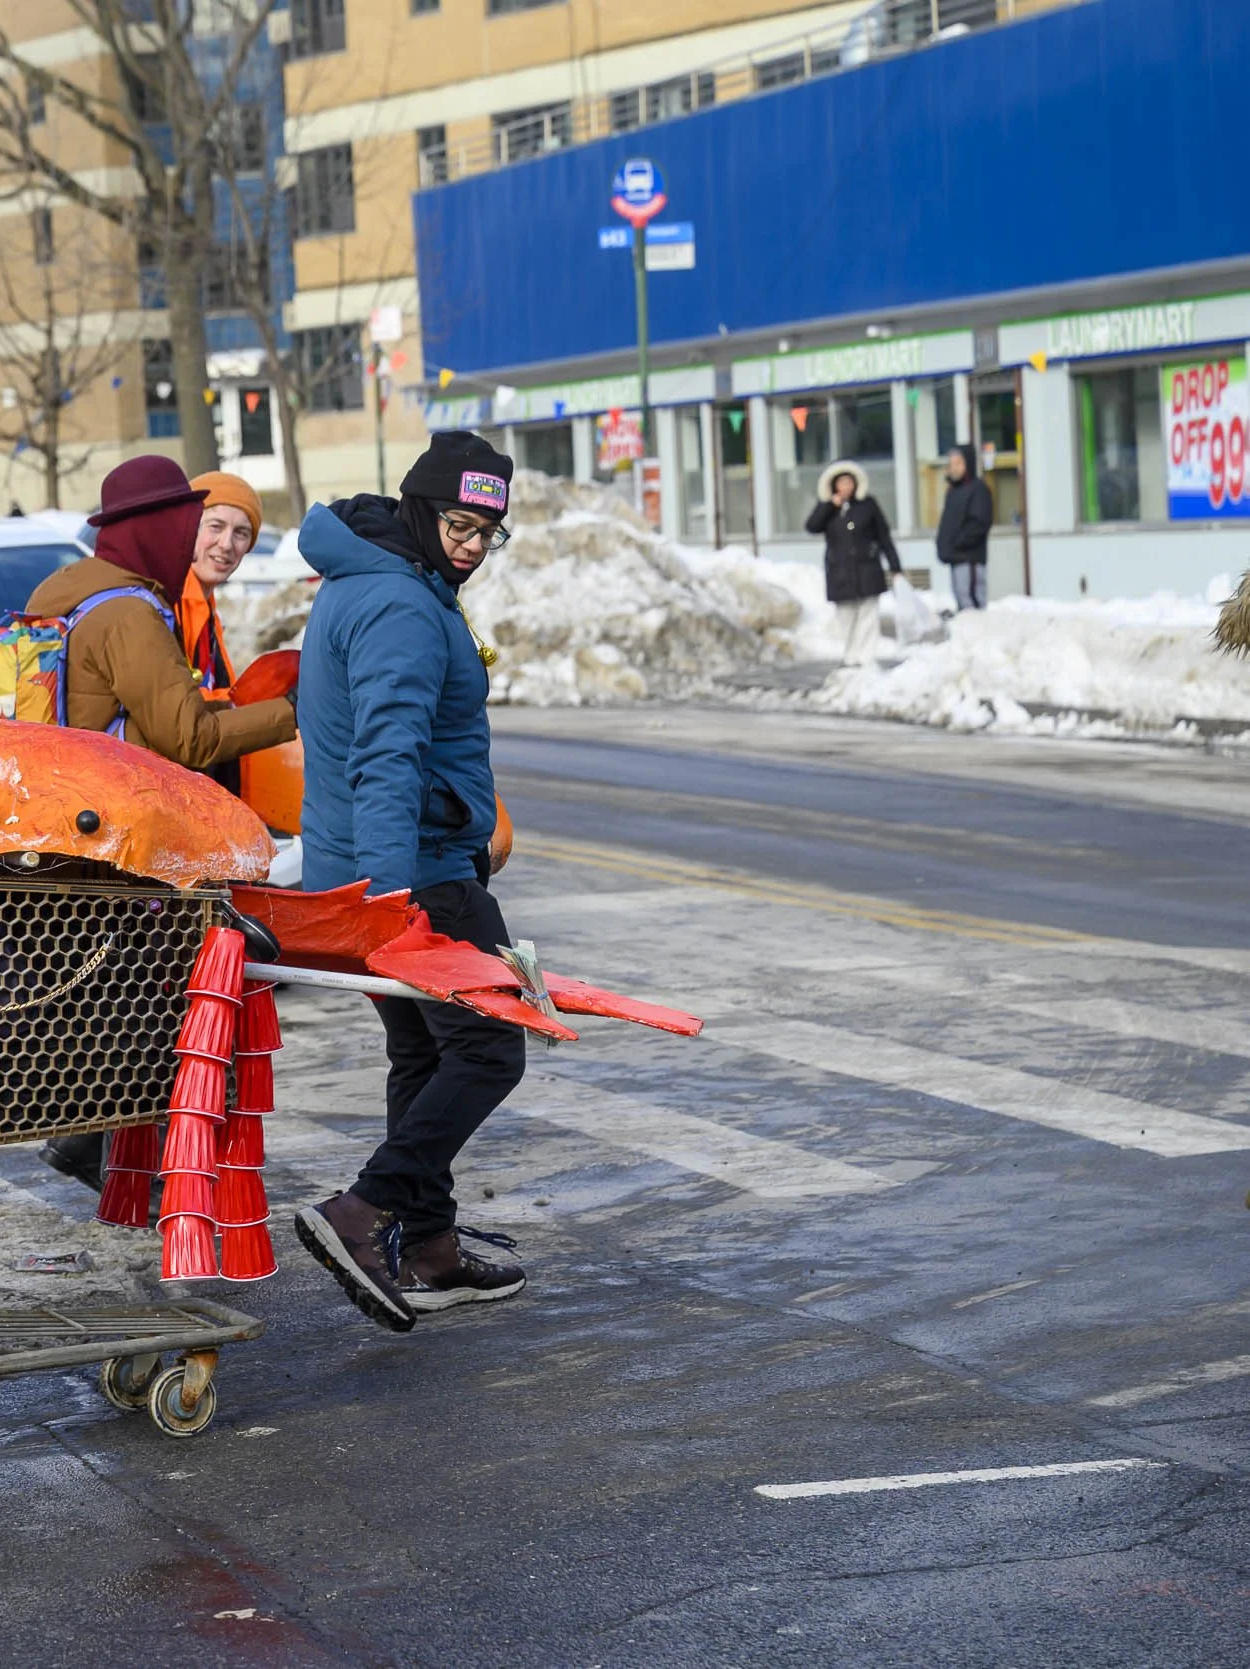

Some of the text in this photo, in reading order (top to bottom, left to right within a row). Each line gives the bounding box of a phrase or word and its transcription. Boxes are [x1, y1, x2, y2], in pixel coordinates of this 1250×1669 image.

[1172, 359, 1229, 416] DROP
[1171, 417, 1209, 467] OFF
[1210, 416, 1250, 508] 99
